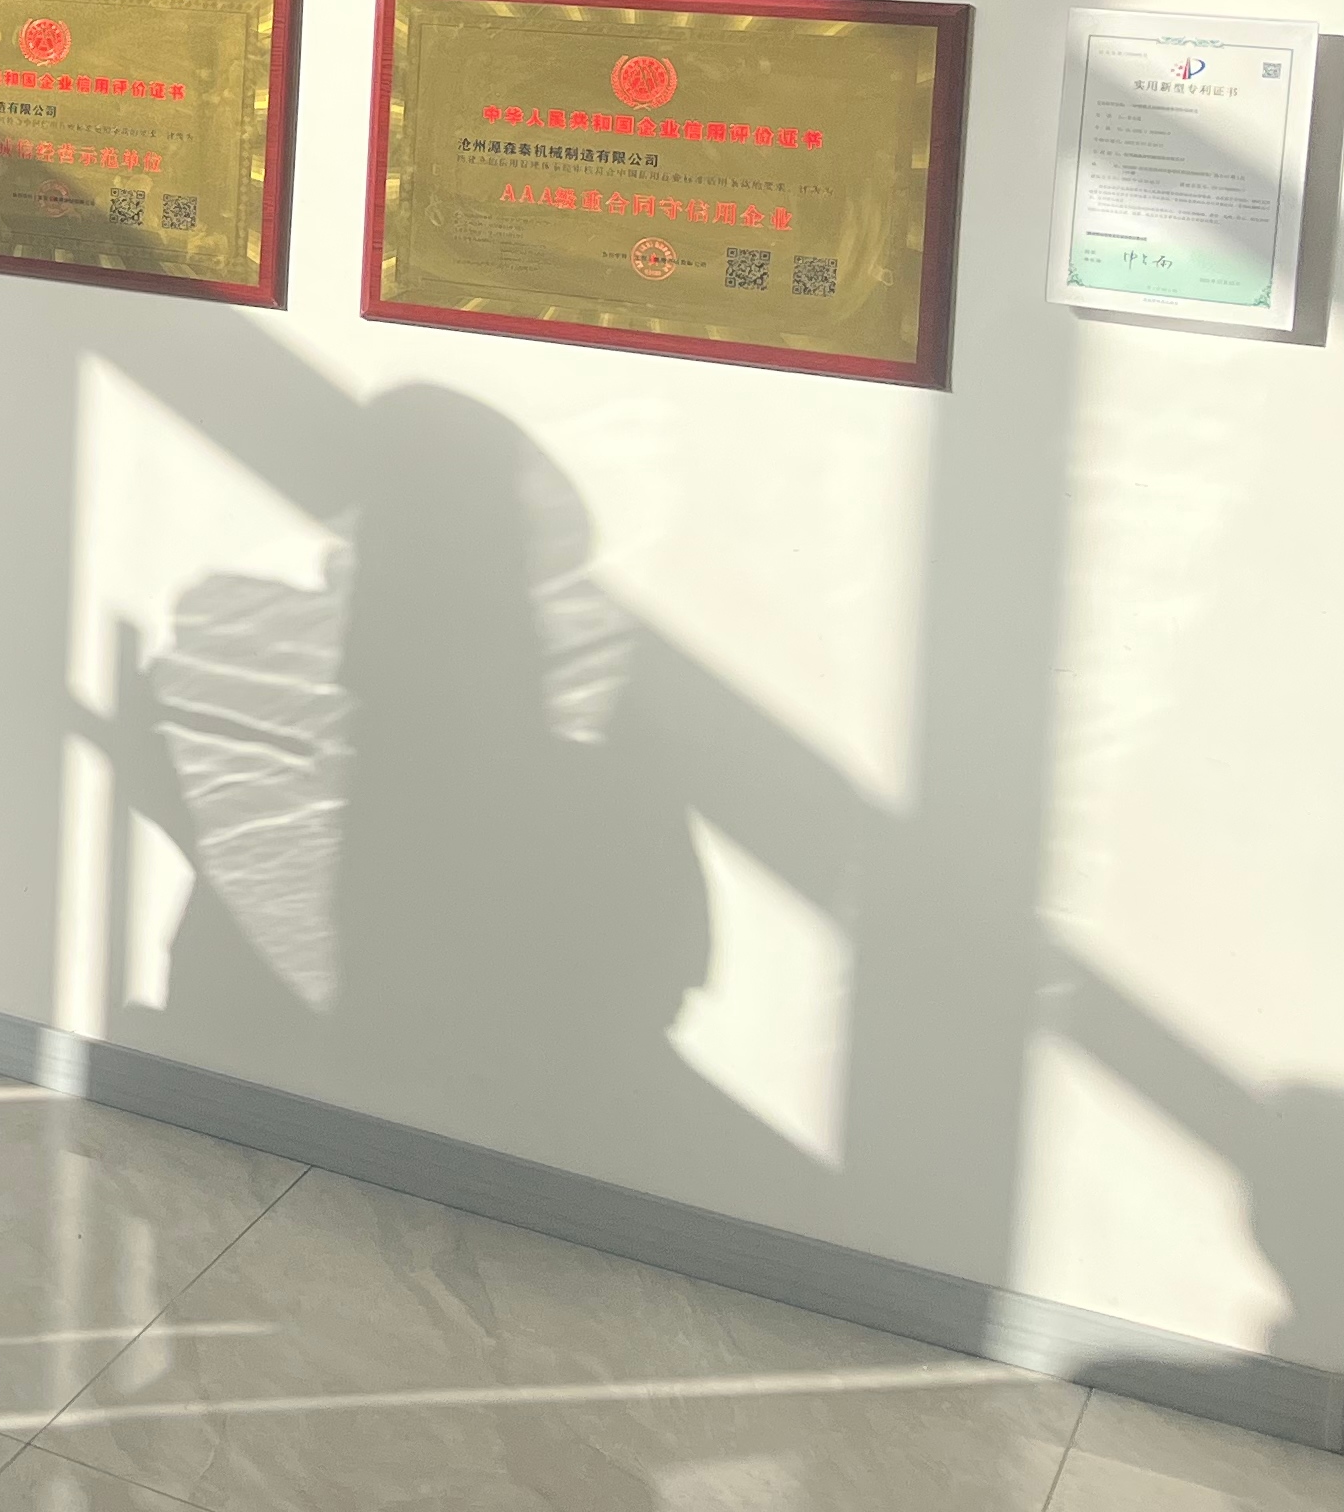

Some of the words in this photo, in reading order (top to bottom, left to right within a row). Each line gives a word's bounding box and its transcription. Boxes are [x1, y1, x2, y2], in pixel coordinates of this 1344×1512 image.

[482, 105, 825, 151] 中华人民共和国企业信用评价证书
[457, 137, 660, 168] 沧州源森泰机械制造有限公司
[500, 183, 793, 231] AAA级重合同守信用企业
